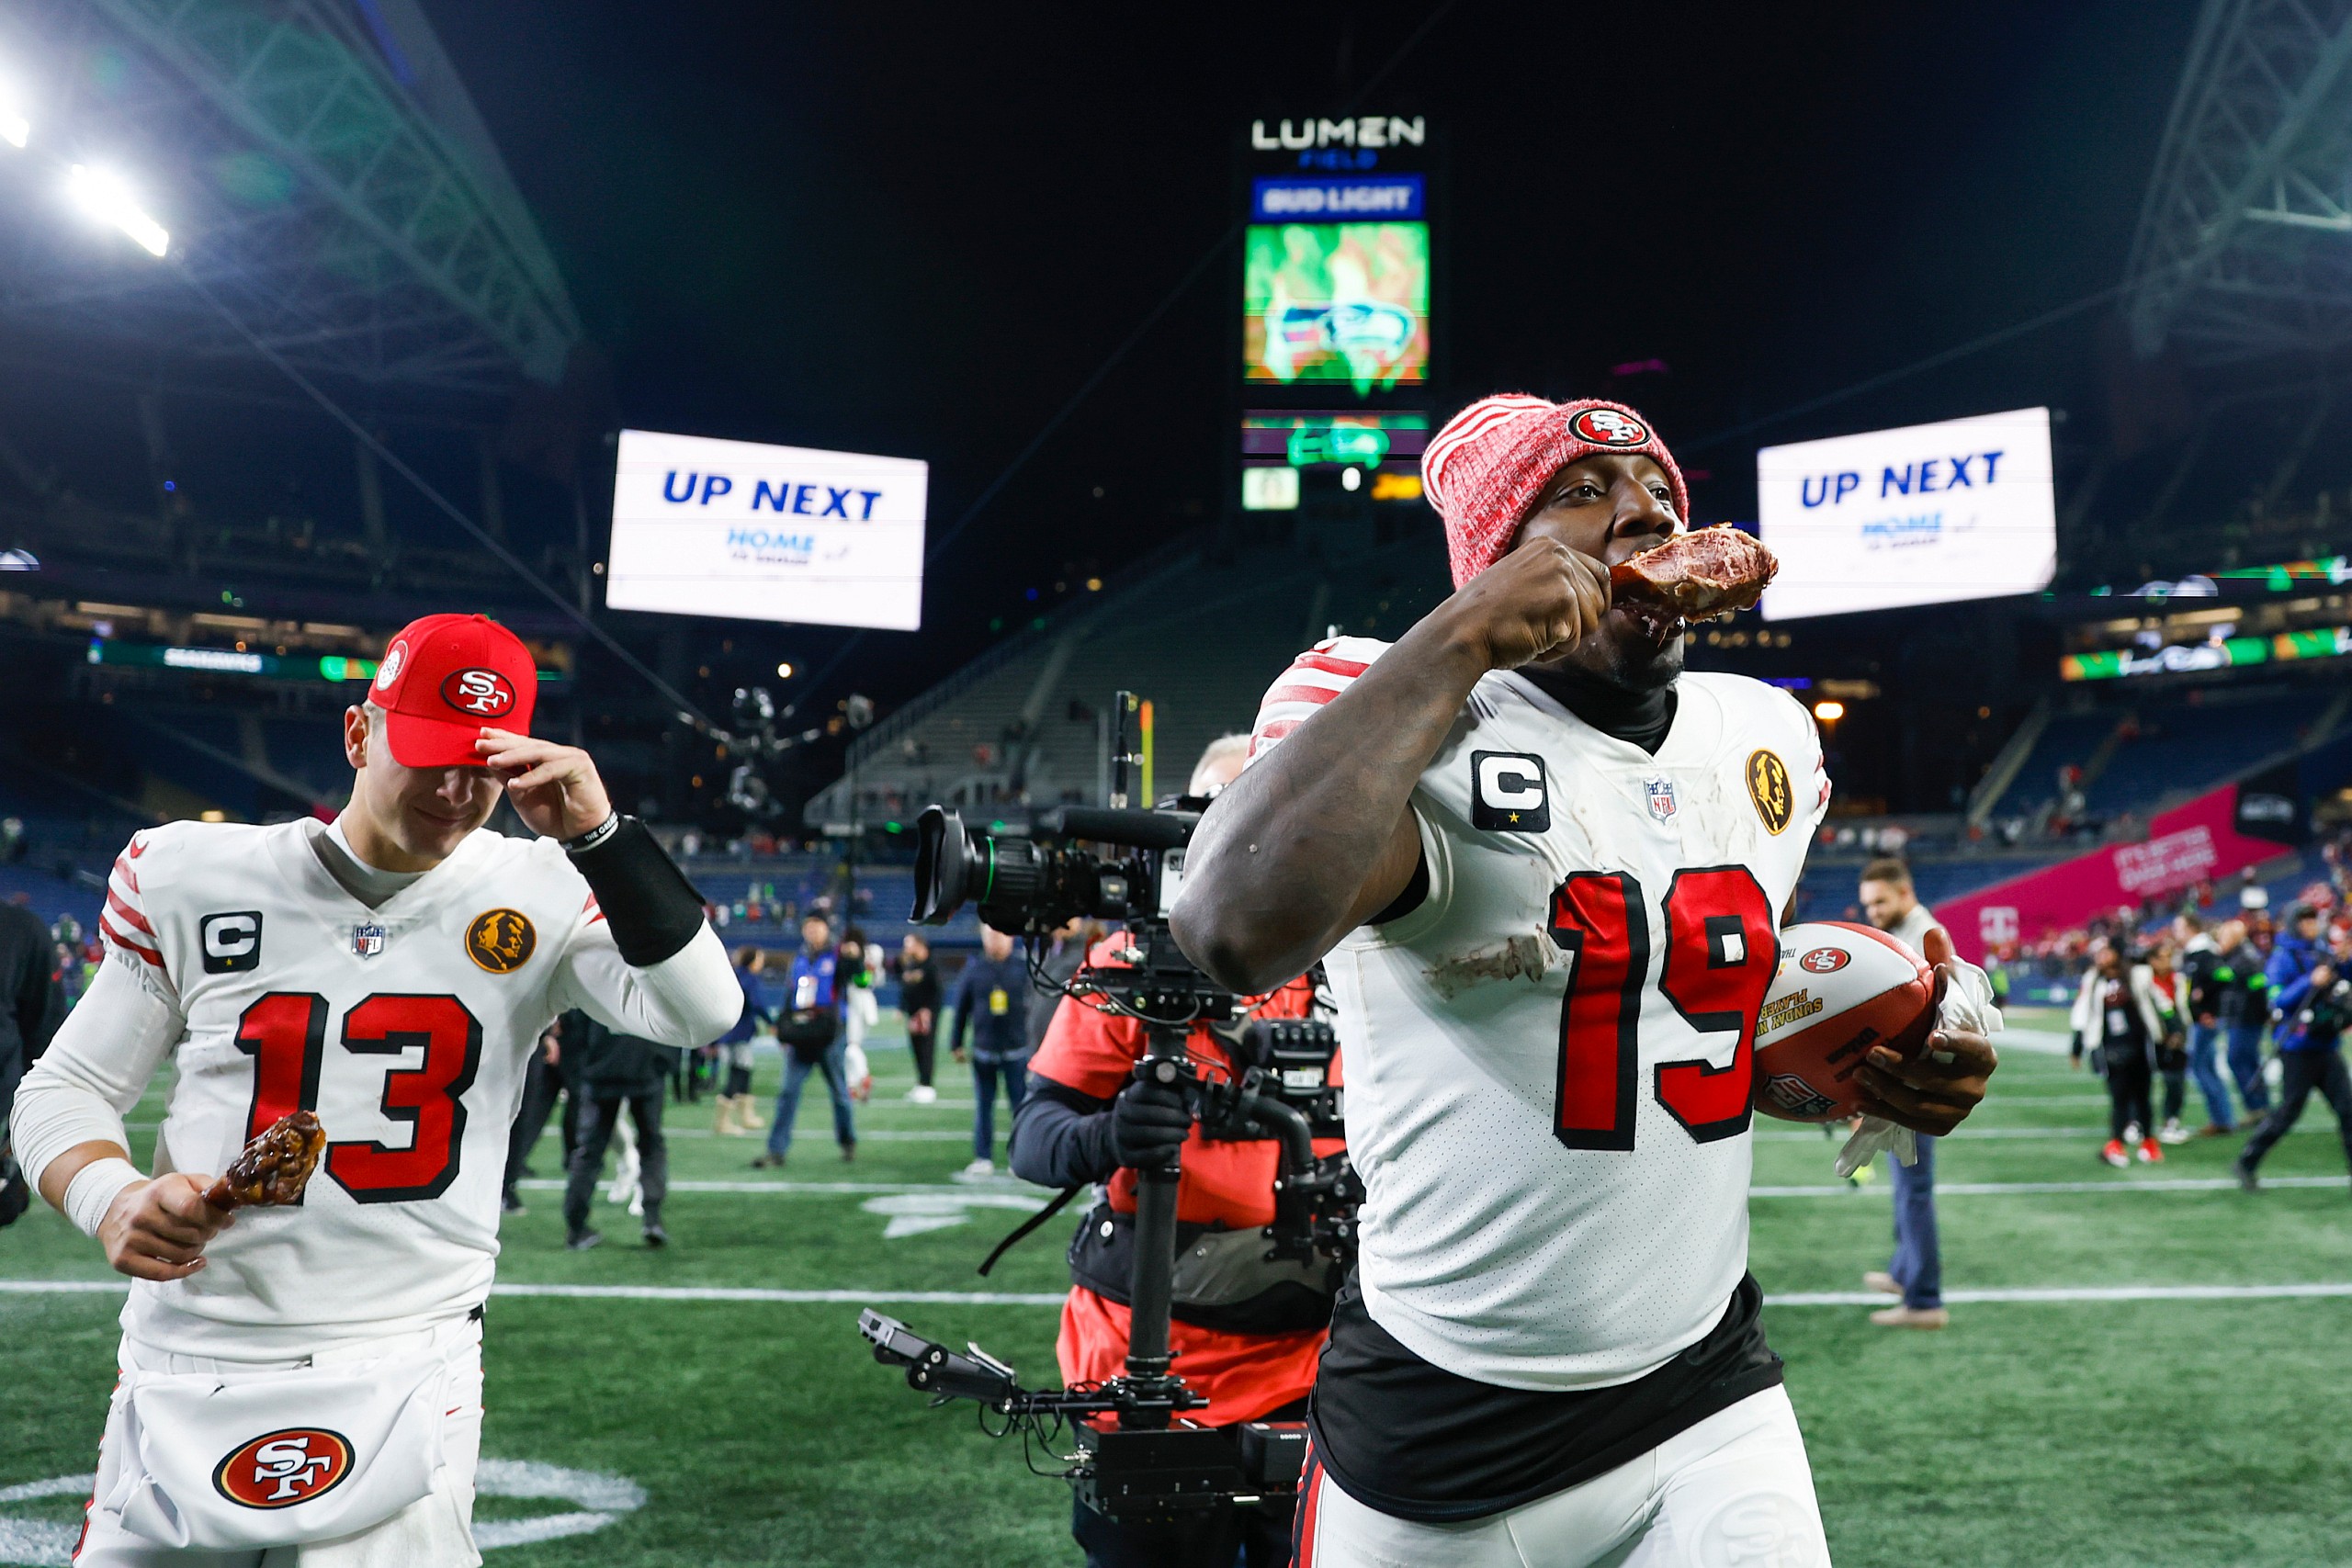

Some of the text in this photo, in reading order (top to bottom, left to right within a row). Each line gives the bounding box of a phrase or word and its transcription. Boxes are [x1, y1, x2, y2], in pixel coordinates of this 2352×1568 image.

[1250, 116, 1426, 151] LUMEN
[1262, 186, 1411, 213] BUD LIGHT
[662, 469, 882, 522] UP NEXT
[1801, 450, 2005, 508] UP NEXT
[727, 526, 816, 555] HOME
[458, 671, 509, 713] SF
[1478, 756, 1544, 811] C
[1653, 796, 1674, 815] NFL
[585, 830, 599, 841] THE
[205, 915, 257, 958] C
[357, 937, 380, 953] NFL
[1547, 863, 1781, 1152] 19
[1760, 987, 1808, 1020] PLAYER
[1771, 998, 1823, 1031] SUNDAY
[233, 991, 483, 1206] 13
[253, 1437, 333, 1502] SF
